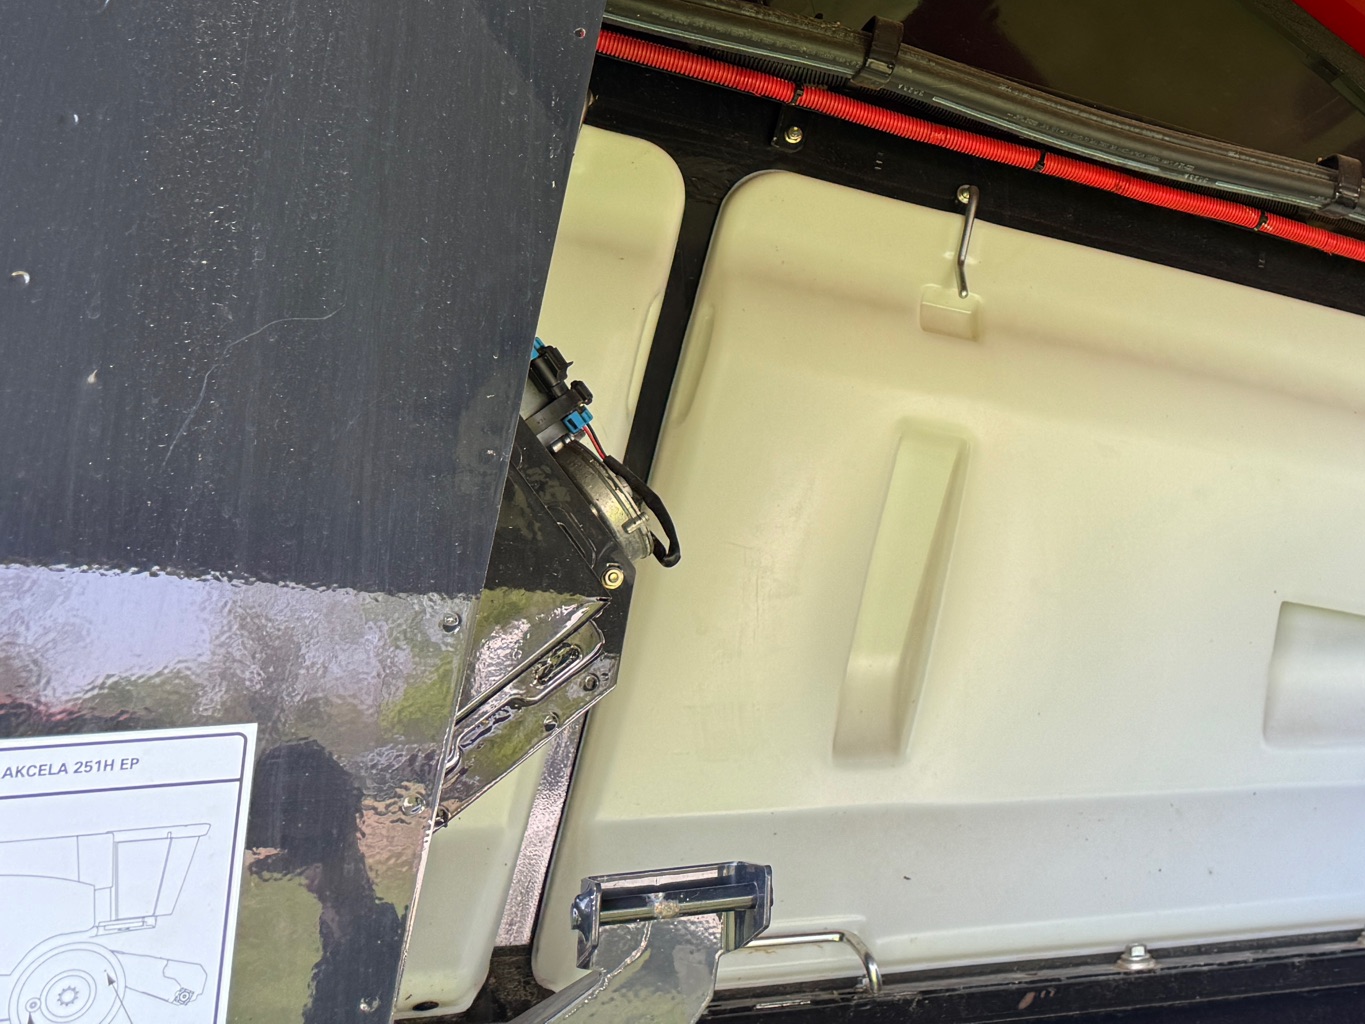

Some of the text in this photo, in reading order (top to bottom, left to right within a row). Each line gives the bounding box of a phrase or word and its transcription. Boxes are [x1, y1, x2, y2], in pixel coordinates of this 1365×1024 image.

[2, 757, 140, 779] AKCELA 251H EP
